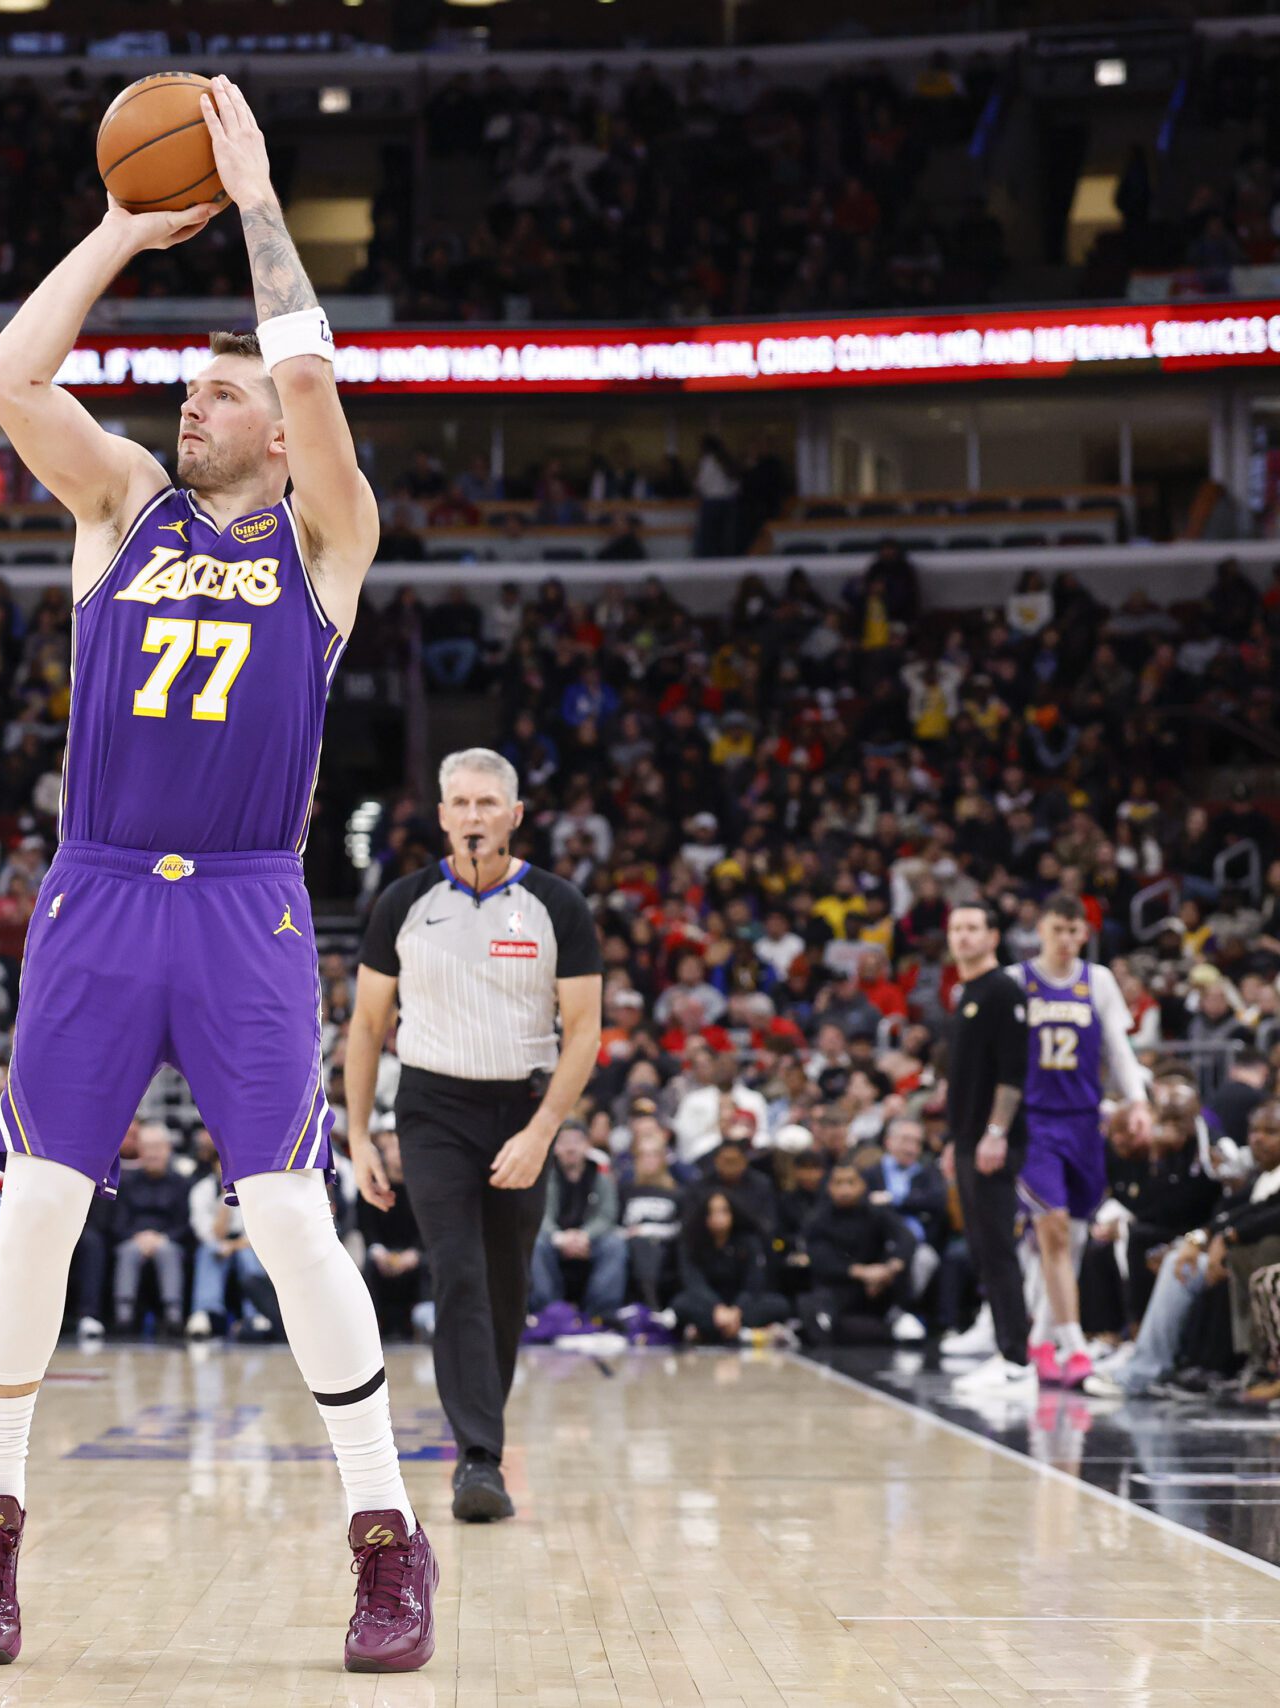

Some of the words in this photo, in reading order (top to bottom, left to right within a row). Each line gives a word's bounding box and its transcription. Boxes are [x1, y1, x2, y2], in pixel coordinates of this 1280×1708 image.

[235, 518, 275, 535] bibigo
[113, 546, 282, 606] LAKERS
[132, 617, 252, 722] 77
[1038, 1027, 1079, 1070] 12
